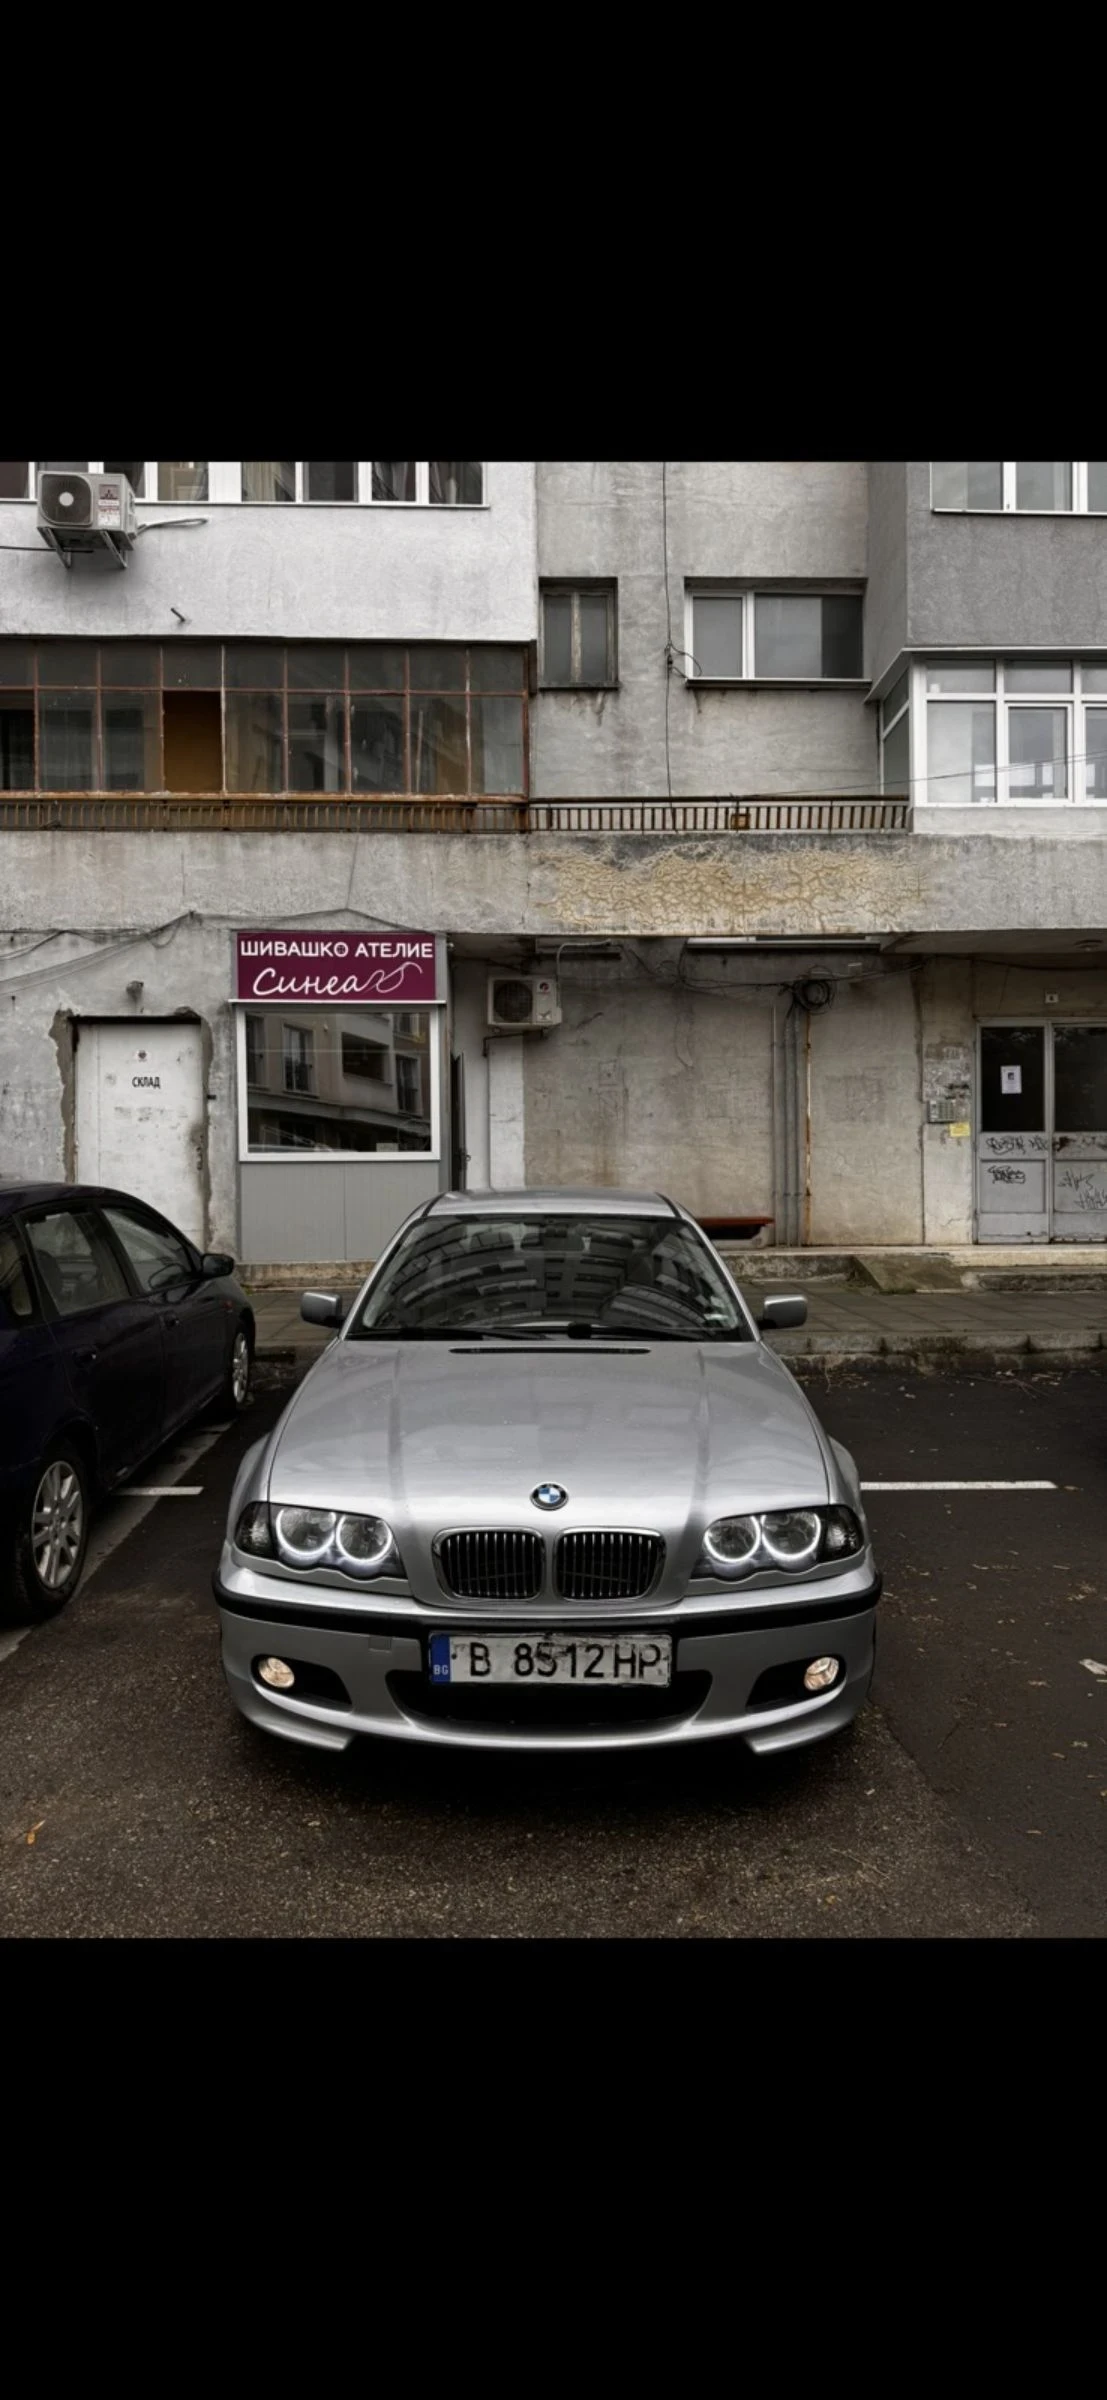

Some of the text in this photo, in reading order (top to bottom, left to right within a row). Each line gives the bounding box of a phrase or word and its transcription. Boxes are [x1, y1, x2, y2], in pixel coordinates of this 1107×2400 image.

[240, 941, 434, 959] ШИВАШКО АТЕЛИЕ
[131, 1076, 162, 1089] СКЛАД
[469, 1641, 492, 1677] B
[513, 1642, 605, 1678] 8512
[432, 1664, 449, 1676] BG
